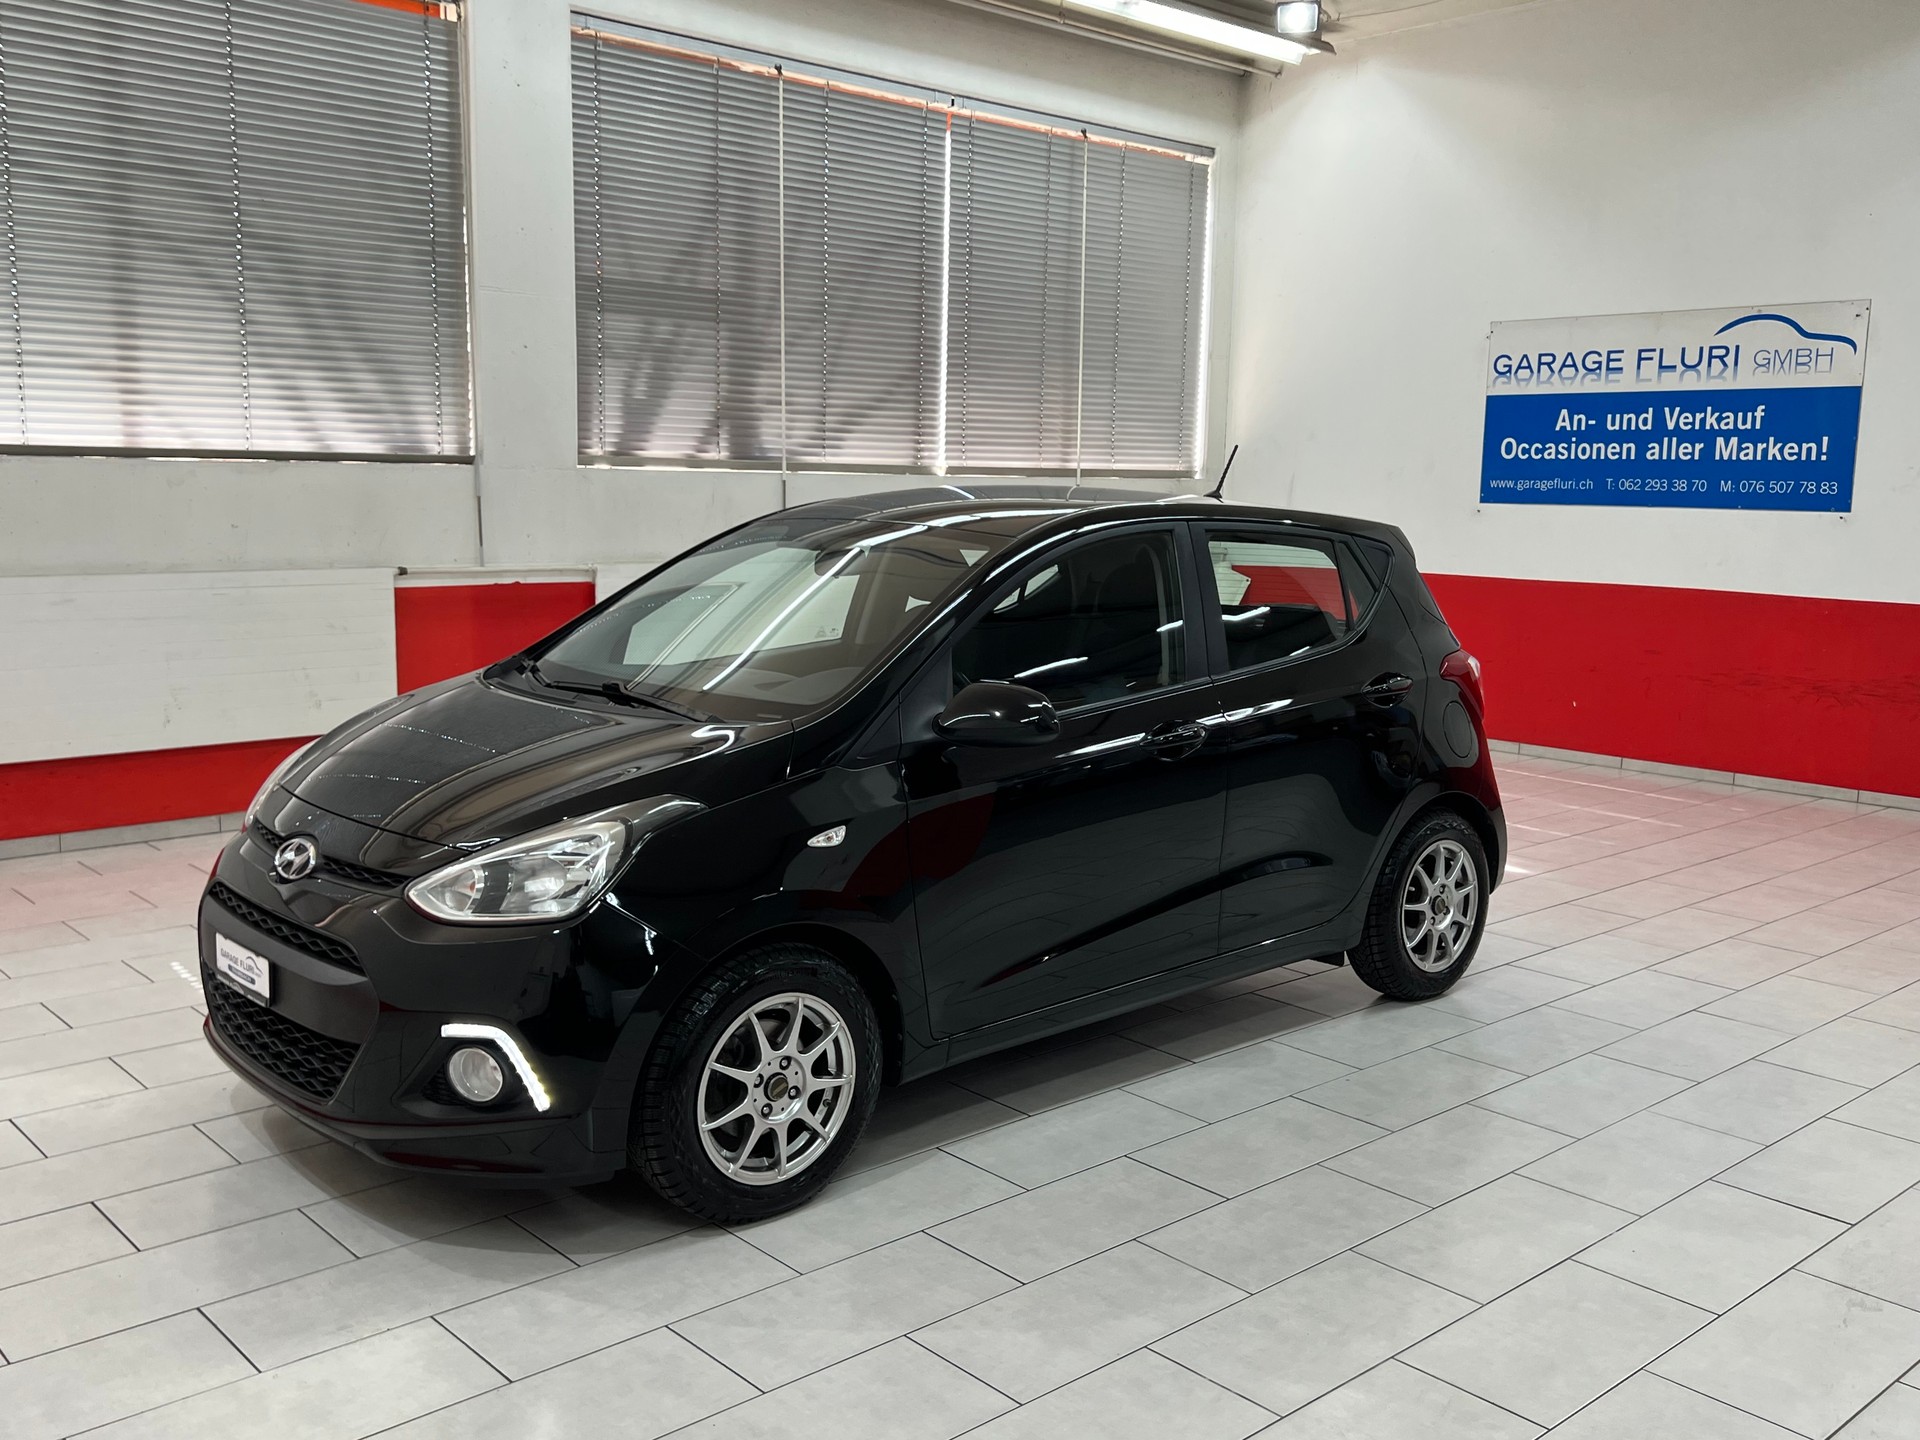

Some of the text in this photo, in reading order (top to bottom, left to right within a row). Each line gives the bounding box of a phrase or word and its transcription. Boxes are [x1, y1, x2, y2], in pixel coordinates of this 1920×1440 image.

[1493, 345, 1834, 376] GARAGE FLURI GMBH
[1555, 405, 1766, 431] An- und Verkauf
[1500, 436, 1829, 461] Occasionen aller Marken!
[1489, 478, 1838, 495] www.garagefluri.ch T: 062 293 38 70 M: 076 507 78 83
